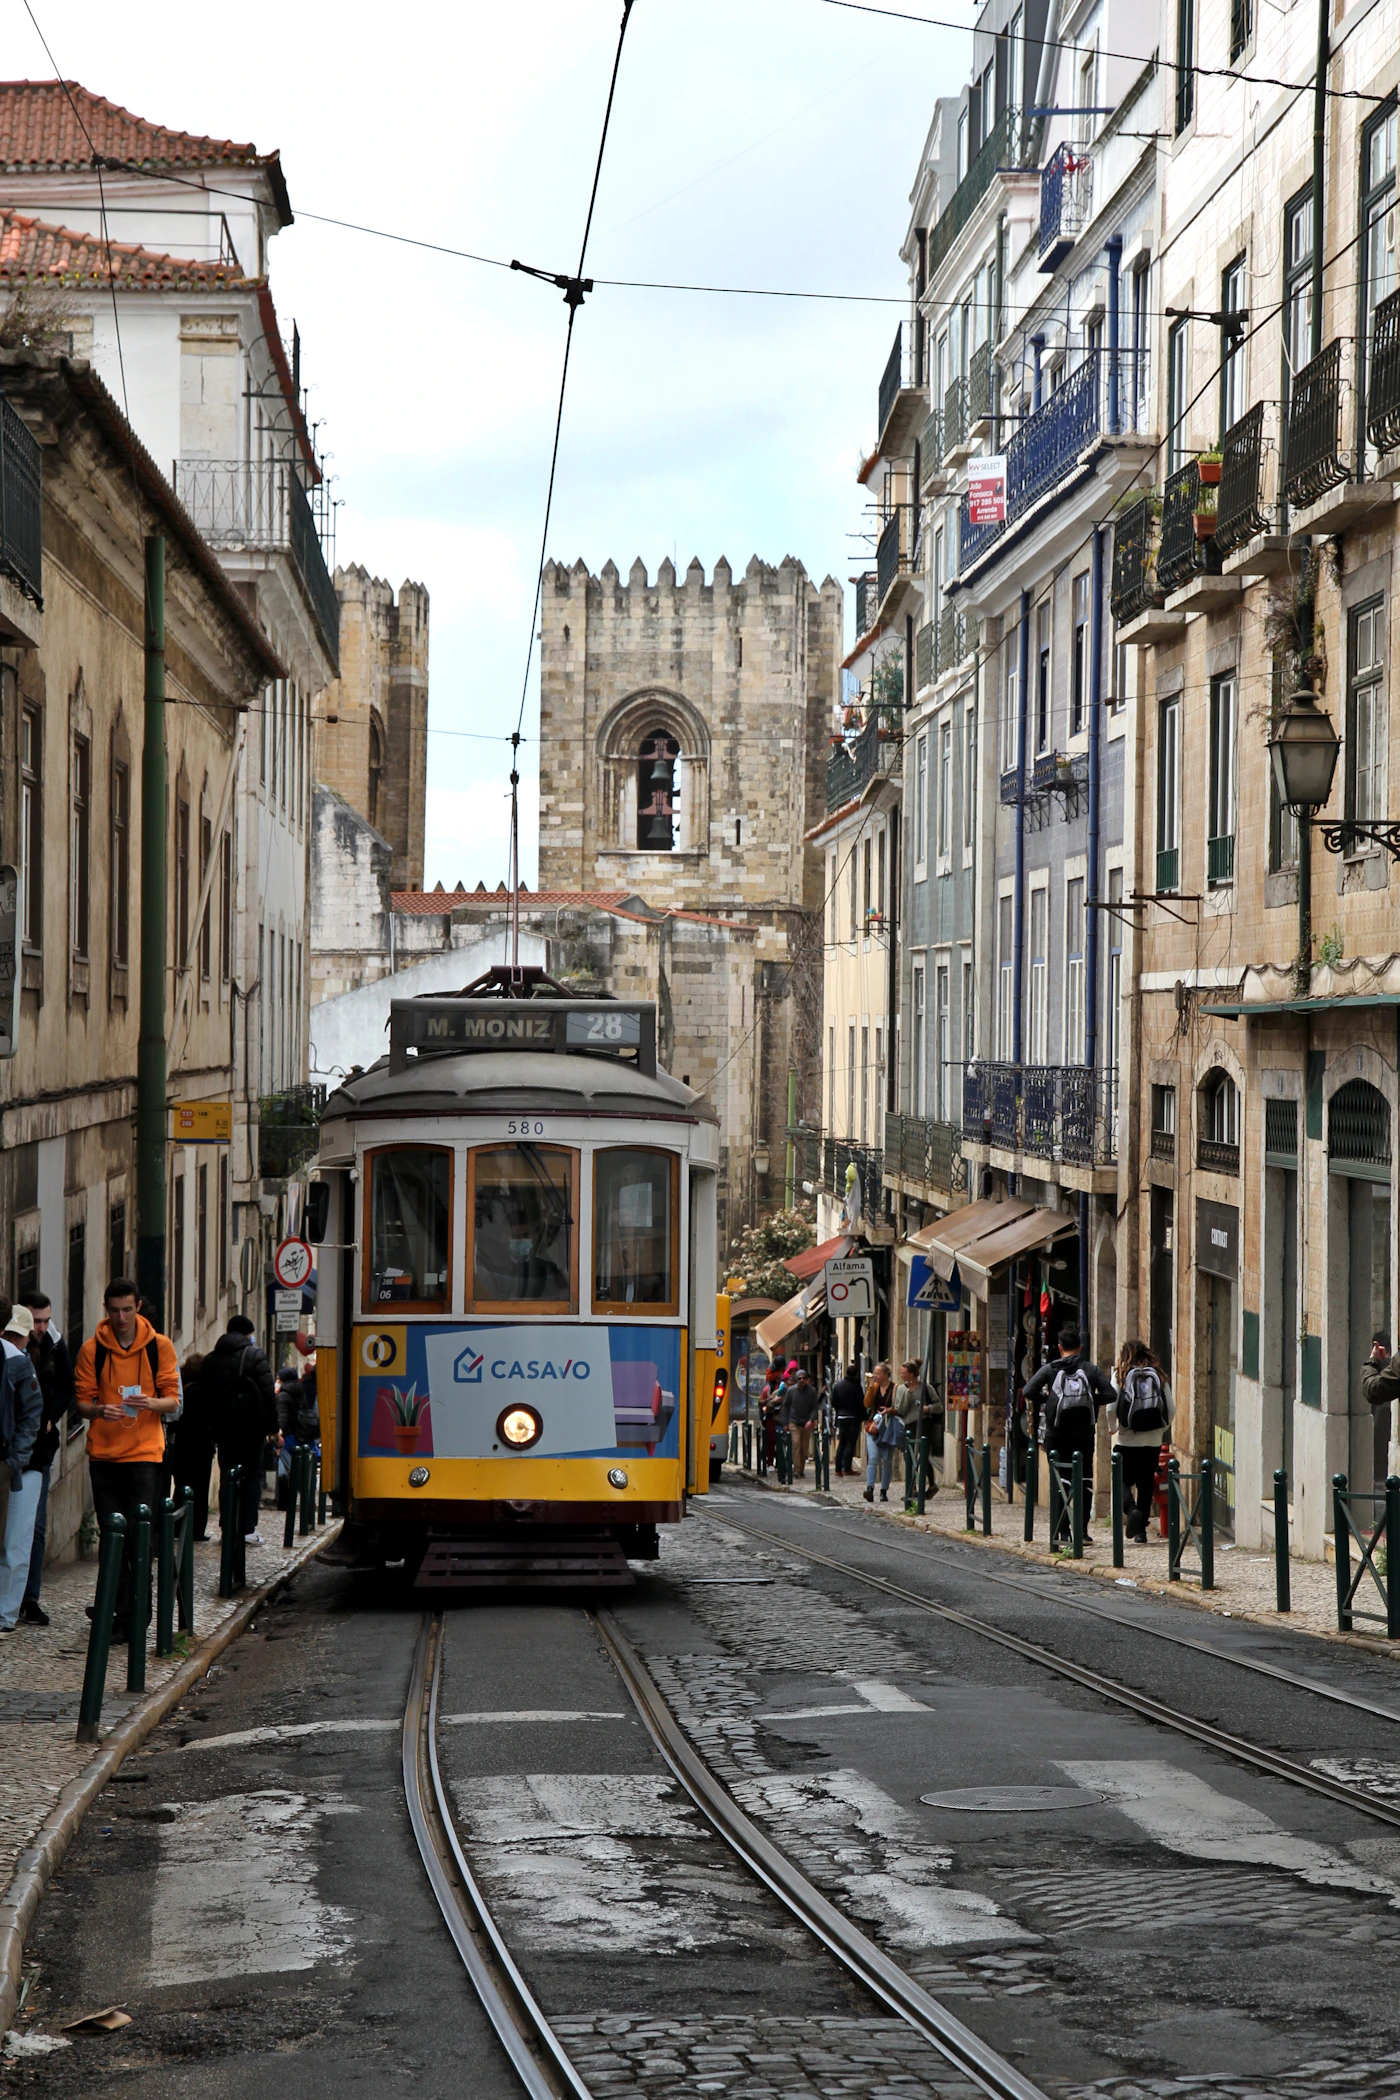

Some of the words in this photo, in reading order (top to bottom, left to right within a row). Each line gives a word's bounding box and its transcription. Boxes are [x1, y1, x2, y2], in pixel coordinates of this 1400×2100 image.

[981, 462, 1000, 470] SELECT
[970, 490, 993, 499] Fonseca
[427, 1018, 455, 1037] M.
[465, 1018, 551, 1038] MONIZ
[586, 1013, 623, 1040] 28
[507, 1121, 544, 1135] 580
[833, 1262, 866, 1271] Alfama
[382, 1278, 394, 1286] 28E
[380, 1290, 392, 1300] 06
[491, 1359, 591, 1380] CASAVO
